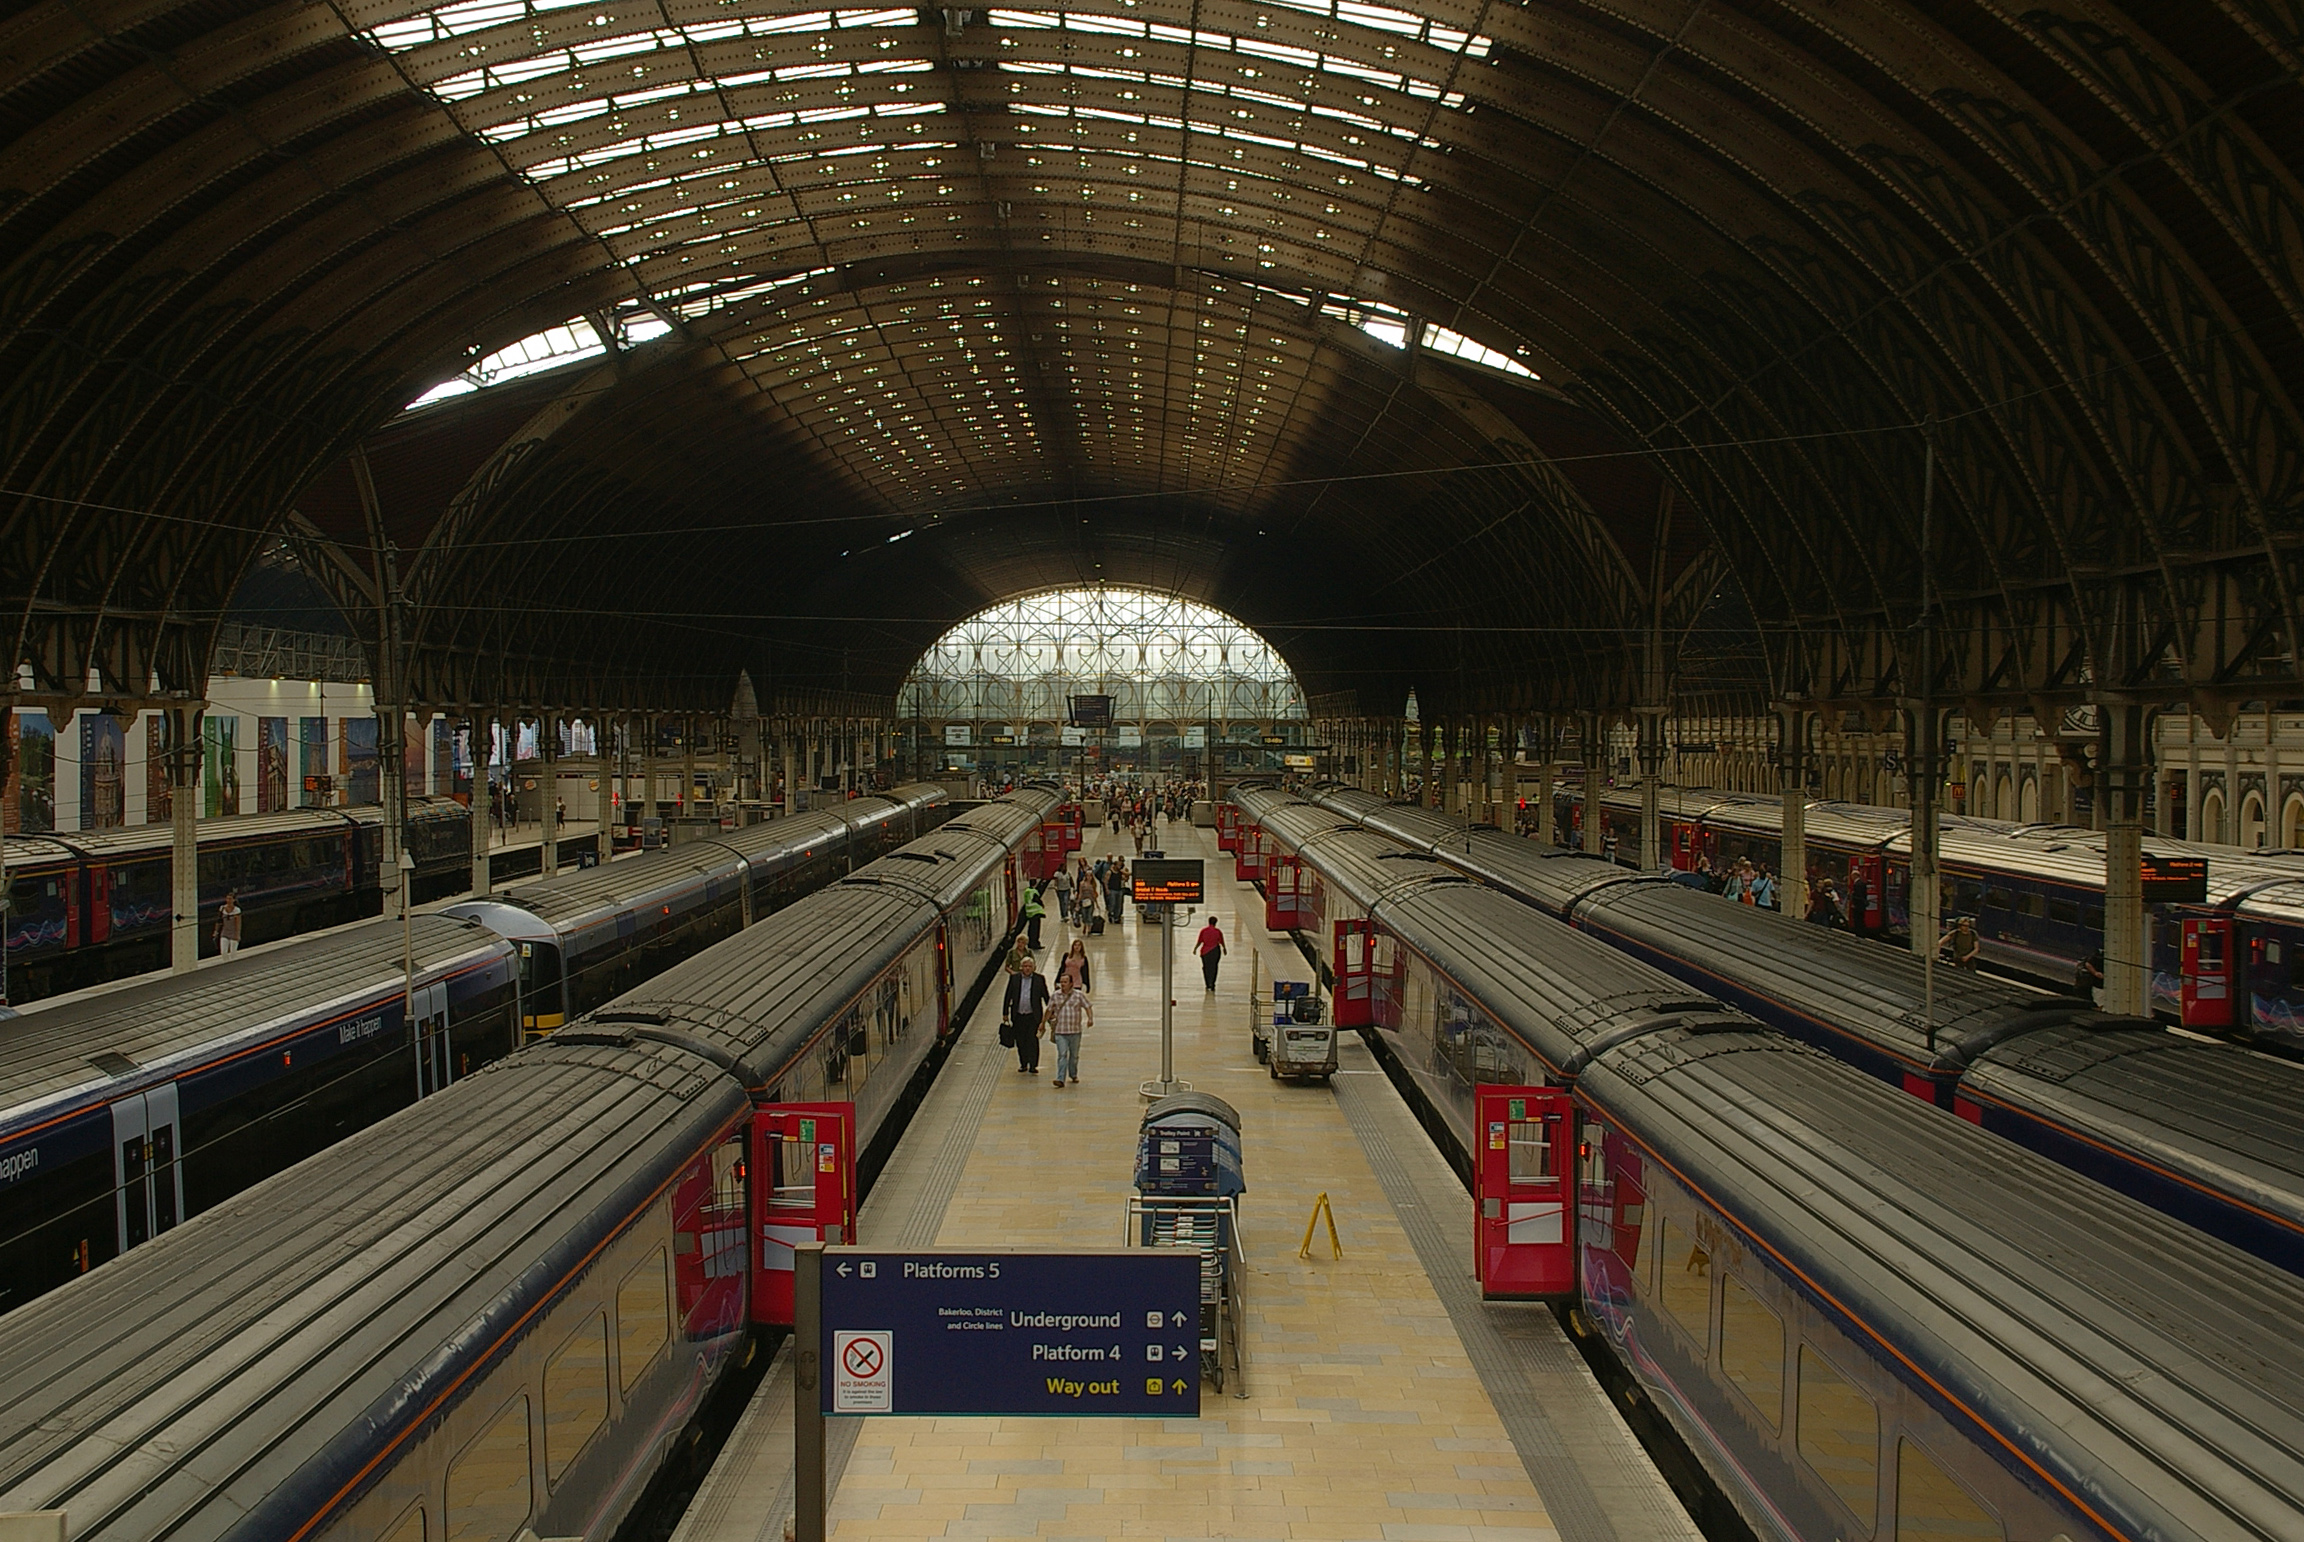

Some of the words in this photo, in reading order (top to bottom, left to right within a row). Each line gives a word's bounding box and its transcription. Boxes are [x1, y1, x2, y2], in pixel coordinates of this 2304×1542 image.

[904, 1262, 985, 1279] Platforms
[988, 1262, 1000, 1279] 5
[938, 1307, 973, 1317] Bakerloo,
[974, 1307, 1003, 1316] District
[1010, 1311, 1121, 1330] Underground
[947, 1321, 961, 1330] and
[962, 1321, 985, 1330] Circle
[985, 1321, 1004, 1330] lines
[1032, 1344, 1105, 1361] Platform
[1108, 1344, 1121, 1361] 4
[1046, 1377, 1085, 1398] Way
[1088, 1378, 1120, 1396] out
